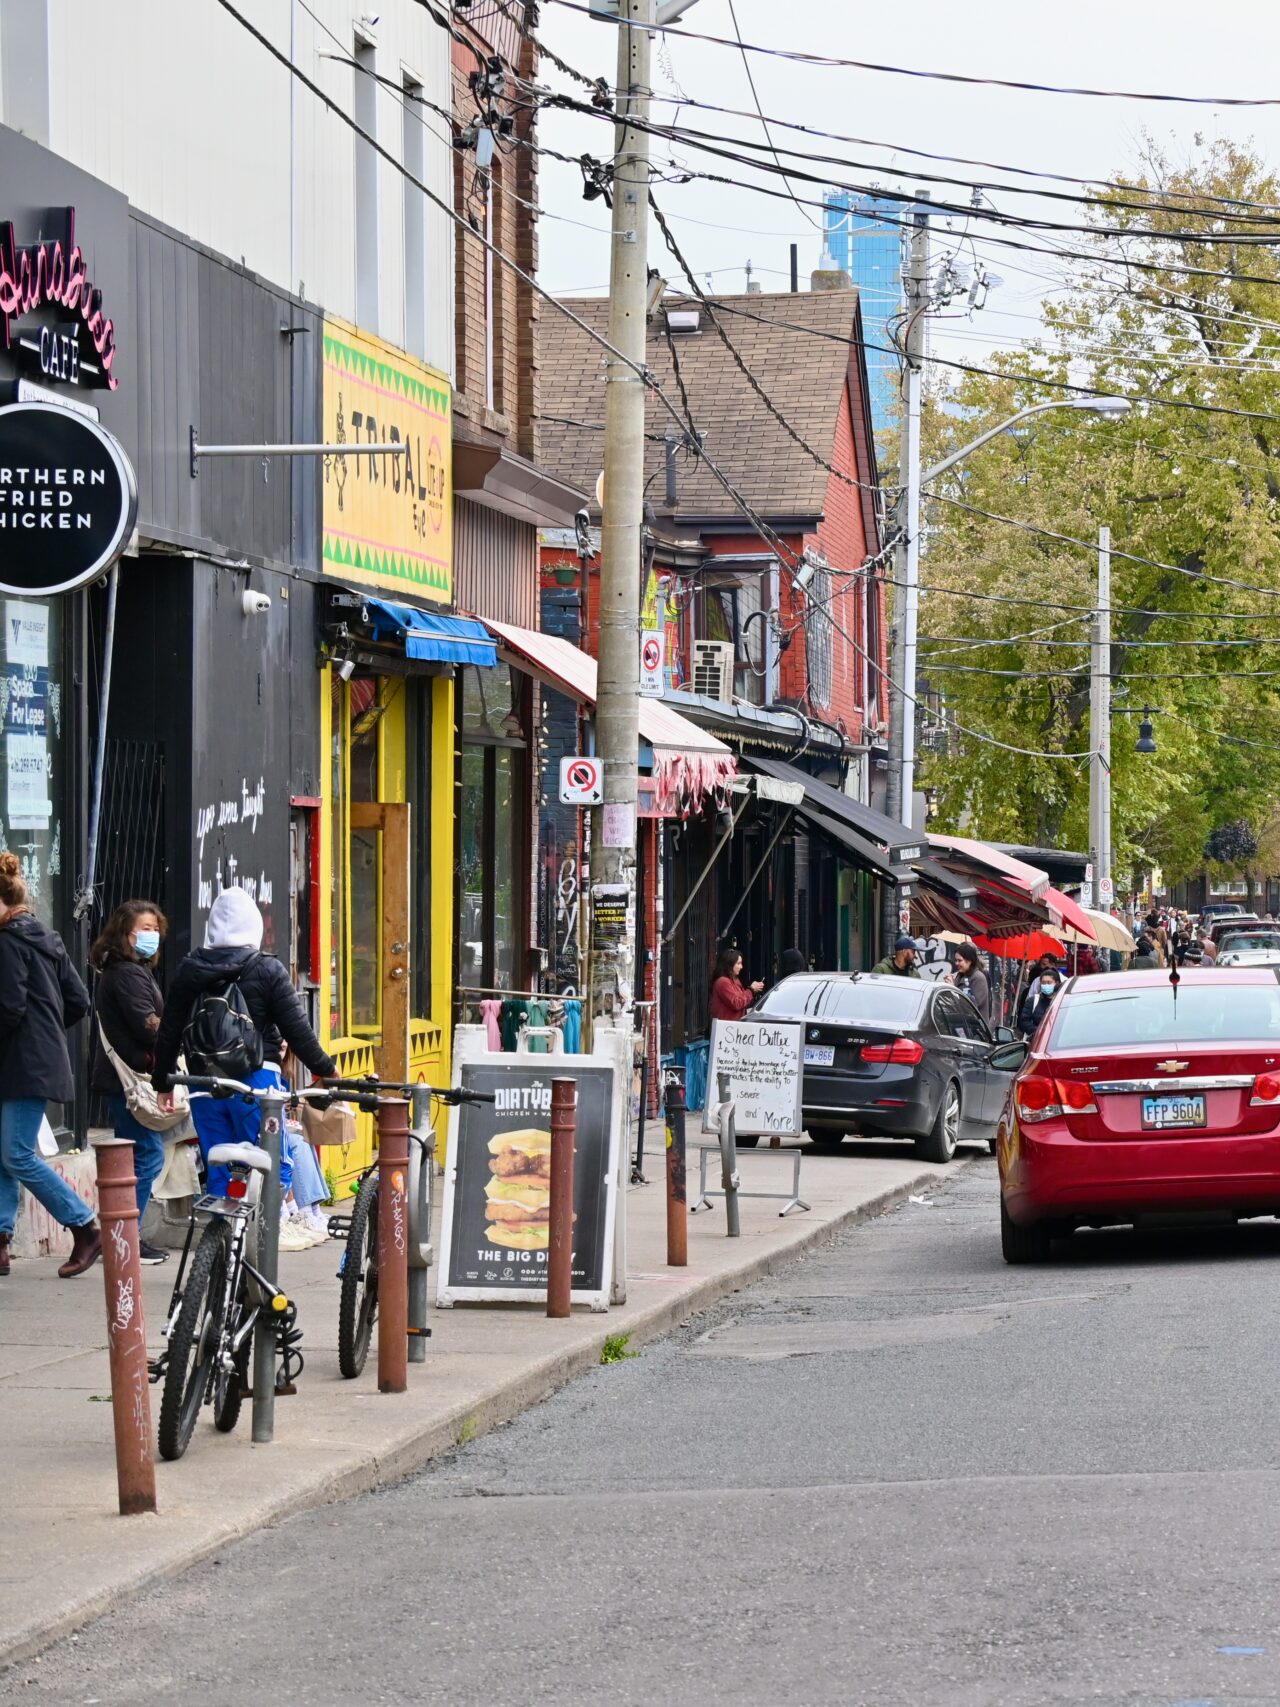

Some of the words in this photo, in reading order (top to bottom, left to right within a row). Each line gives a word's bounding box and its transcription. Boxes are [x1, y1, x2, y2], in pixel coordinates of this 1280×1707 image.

[40, 323, 79, 385] CAFÉ
[352, 411, 427, 500] TRIBAL
[12, 701, 24, 724] For
[25, 702, 44, 726] Lease
[725, 1026, 755, 1047] Shea
[759, 1028, 790, 1047] Butter
[531, 1080, 544, 1088] The
[763, 1110, 797, 1132] More!
[1146, 1104, 1169, 1121] FFP
[1172, 1102, 1202, 1120] 9604
[477, 1250, 502, 1262] THE
[507, 1251, 531, 1263] BIG
